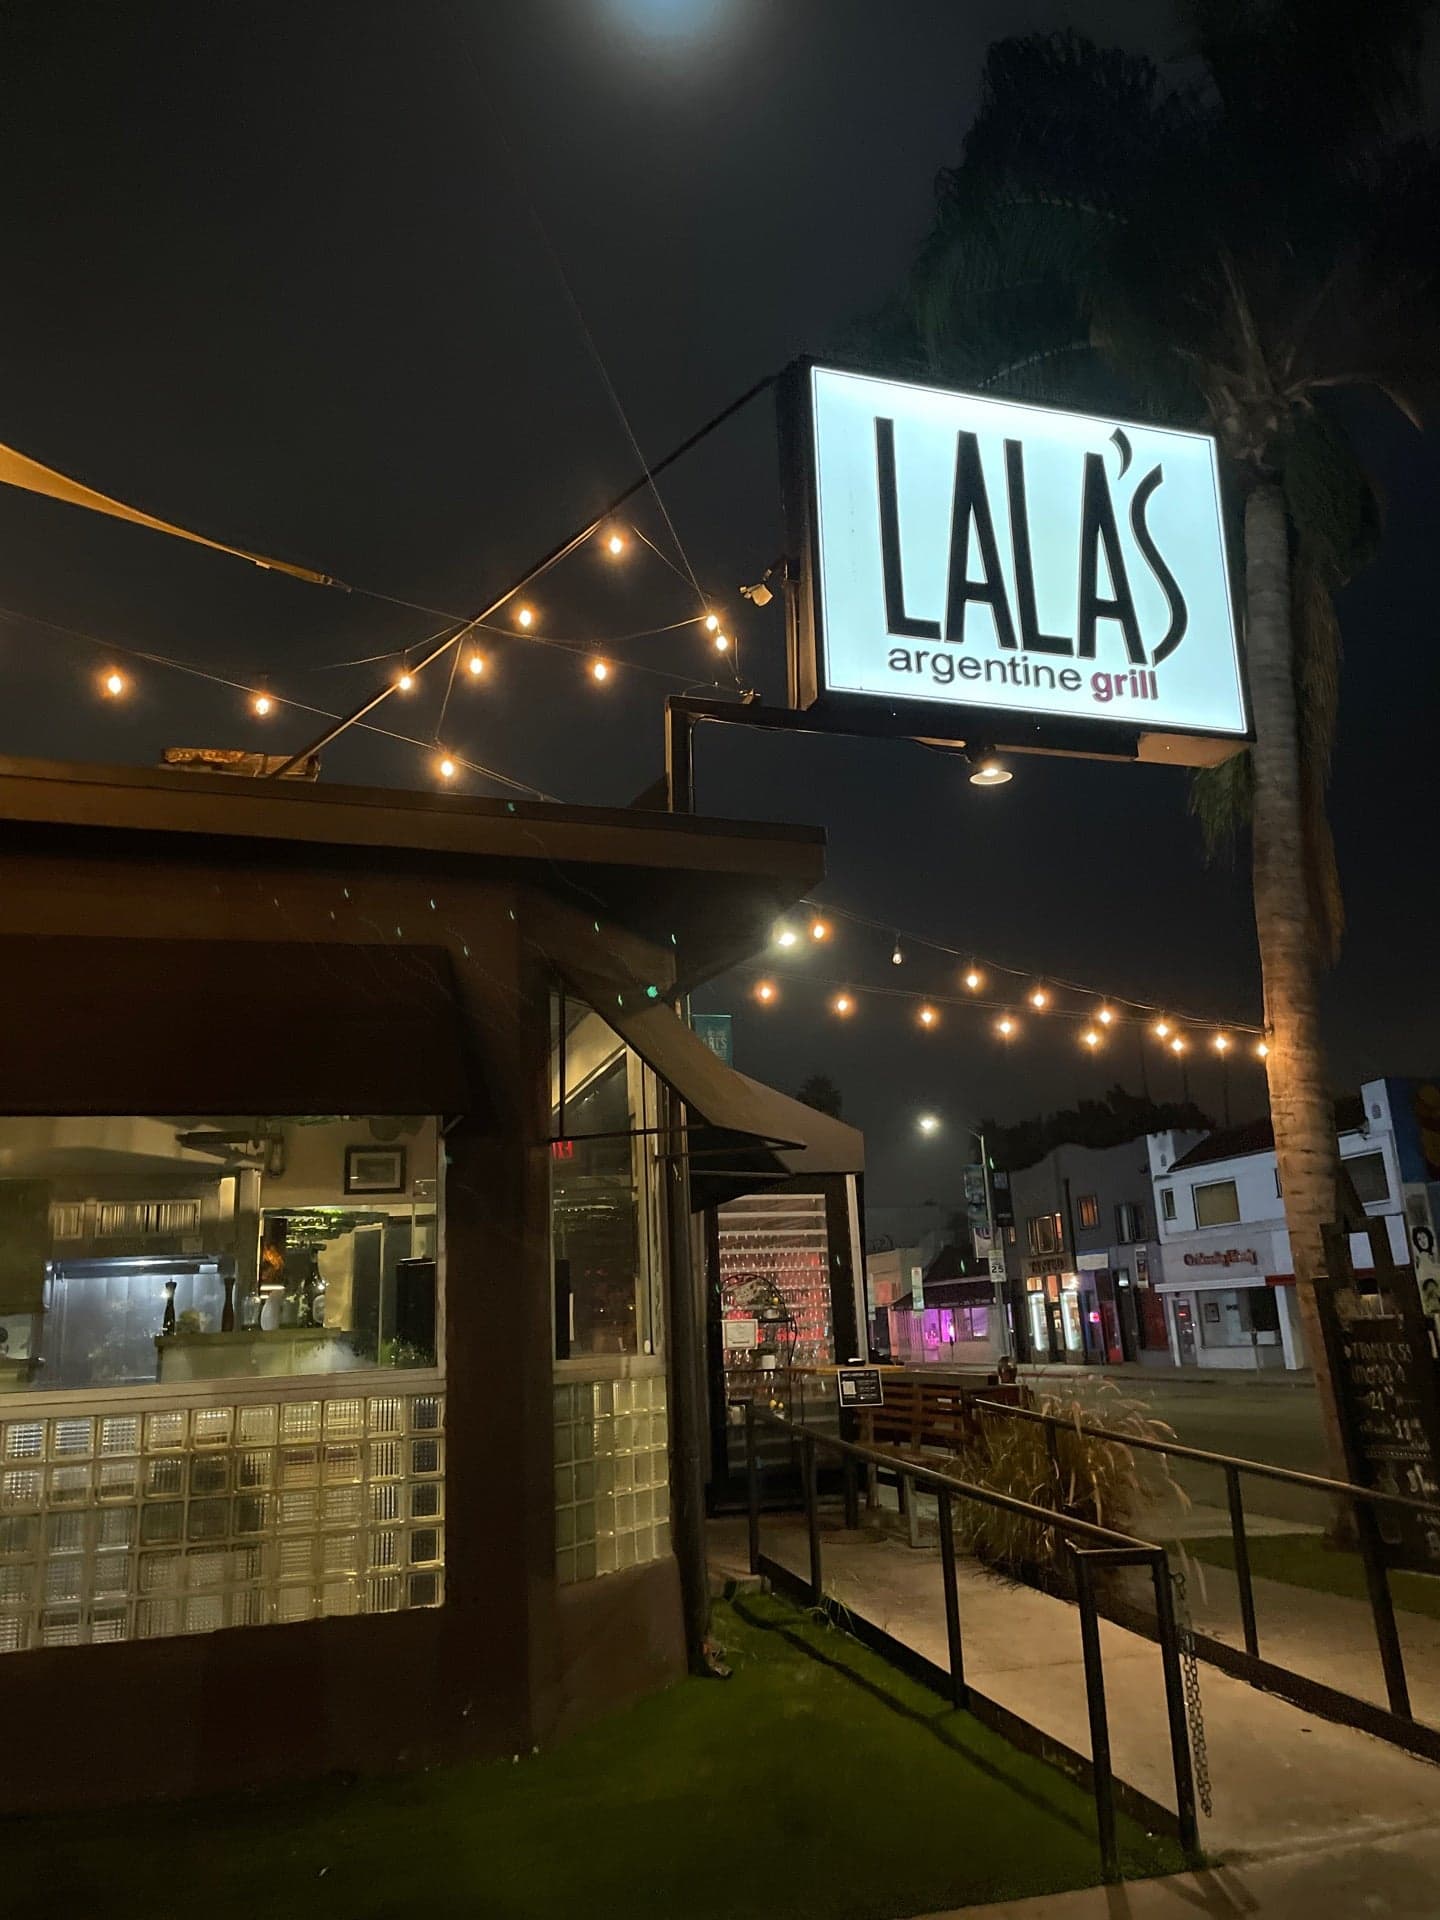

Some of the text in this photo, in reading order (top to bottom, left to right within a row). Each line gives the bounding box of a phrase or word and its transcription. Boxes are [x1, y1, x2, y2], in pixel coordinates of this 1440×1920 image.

[873, 416, 1188, 667] LALA'S
[887, 645, 1160, 703] argentine grill
[991, 1264, 1005, 1274] 25
